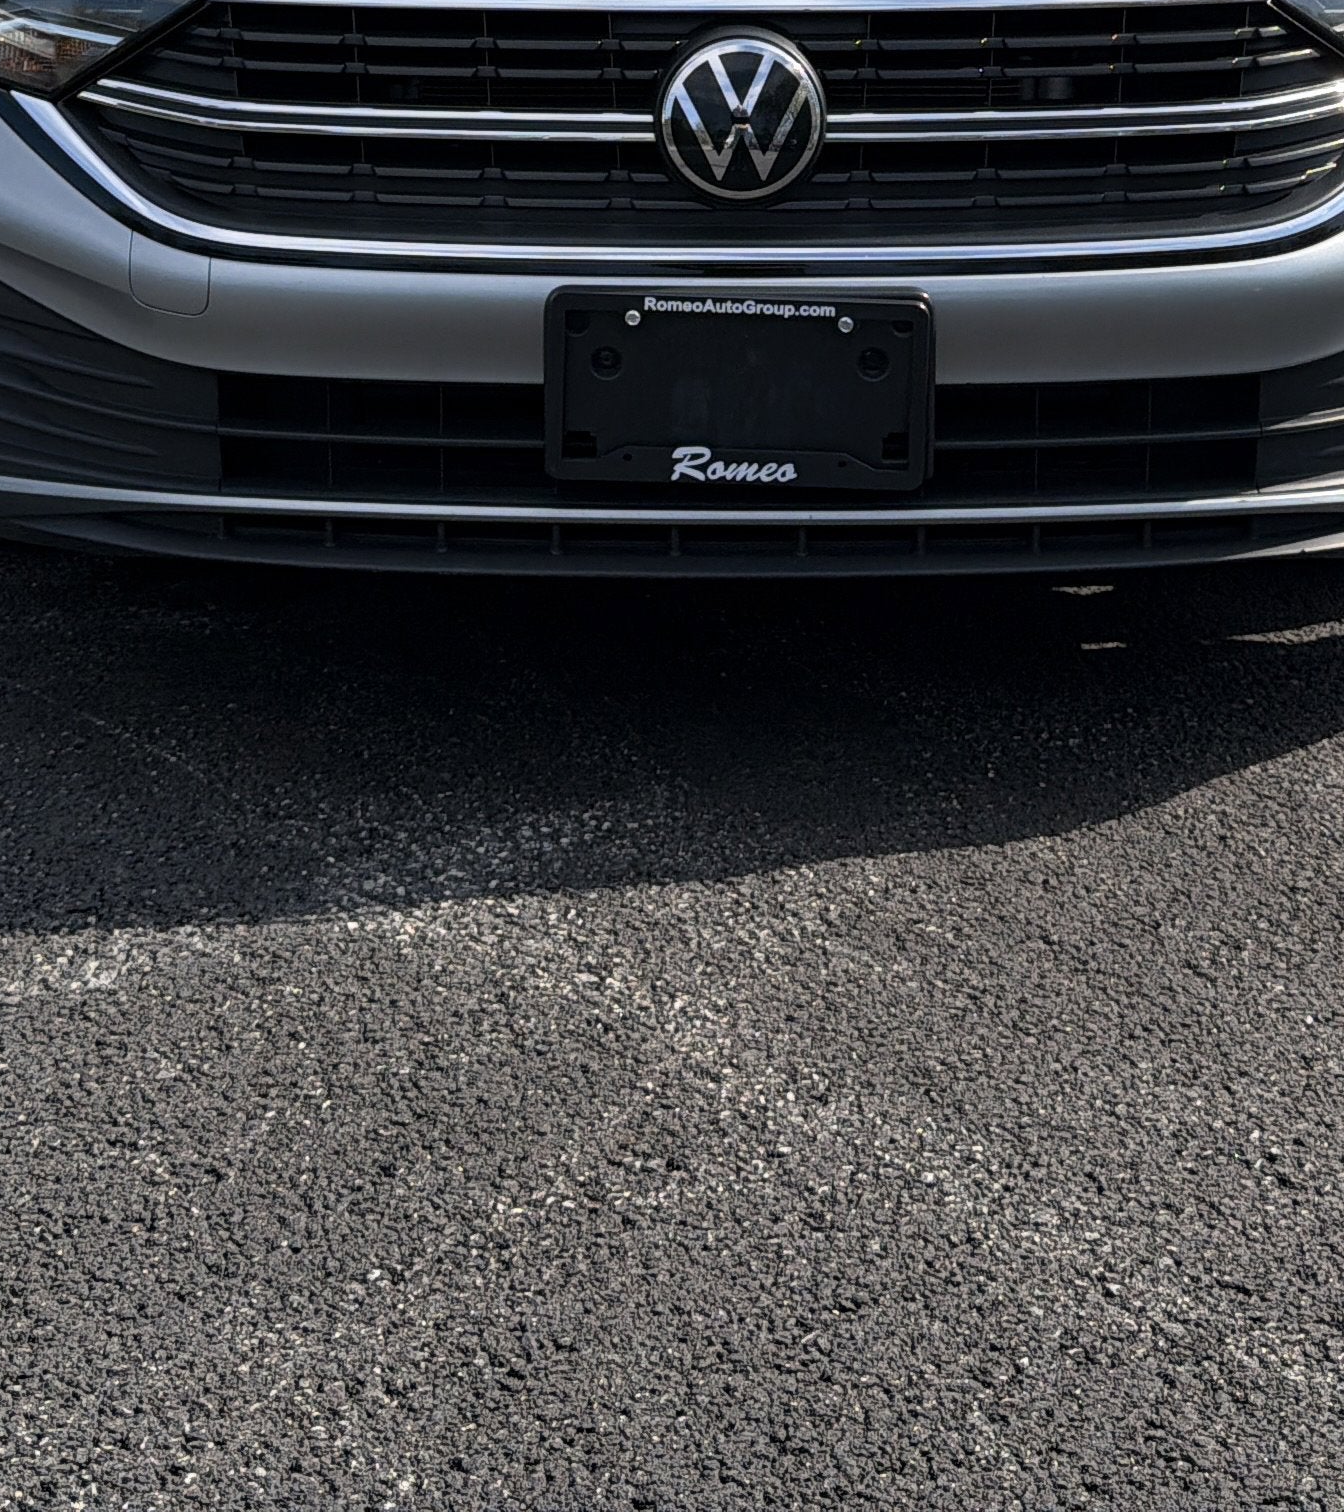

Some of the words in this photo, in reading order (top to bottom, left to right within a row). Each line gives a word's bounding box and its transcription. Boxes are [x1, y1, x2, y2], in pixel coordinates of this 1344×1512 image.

[666, 44, 815, 188] VW
[644, 296, 836, 318] RomeoAutoGroup.com
[671, 446, 797, 483] Romeo
